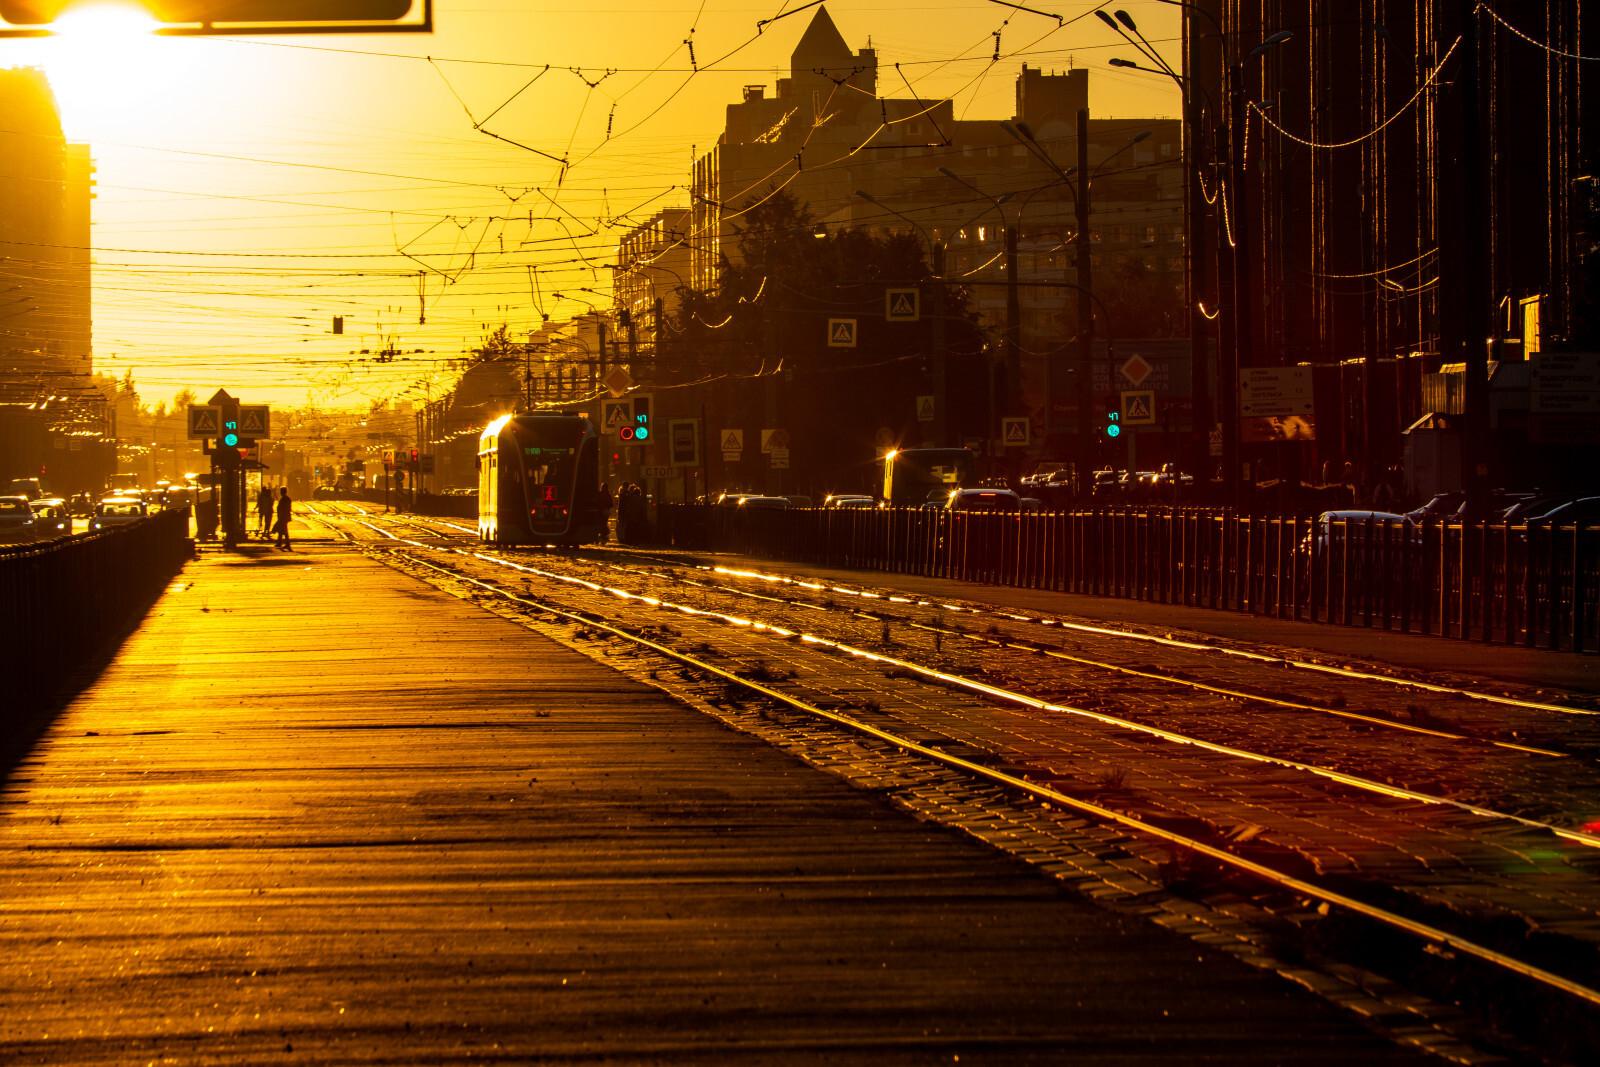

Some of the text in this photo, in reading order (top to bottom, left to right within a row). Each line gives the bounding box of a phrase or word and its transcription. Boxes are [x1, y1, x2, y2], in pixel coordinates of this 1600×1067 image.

[637, 414, 647, 423] 47
[1108, 412, 1119, 421] 47
[225, 421, 237, 430] 47
[646, 467, 673, 477] СТОП
